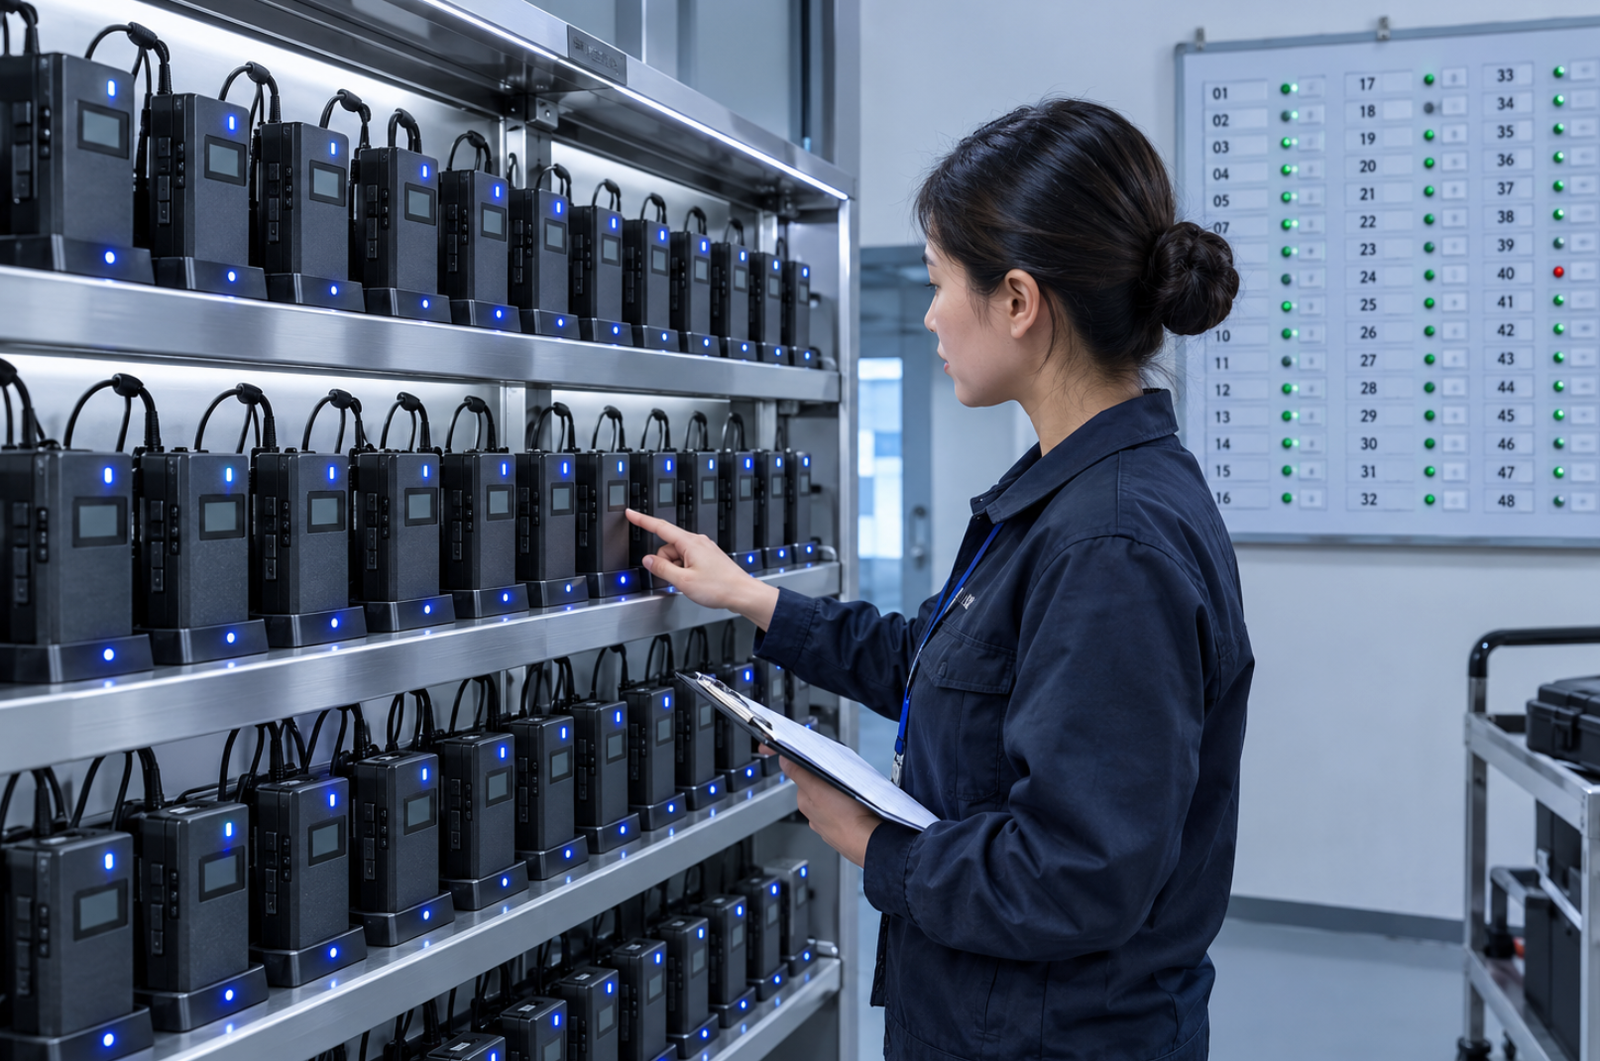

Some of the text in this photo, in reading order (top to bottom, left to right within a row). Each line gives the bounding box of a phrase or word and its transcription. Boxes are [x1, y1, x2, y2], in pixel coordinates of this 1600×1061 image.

[1497, 68, 1514, 83] 33
[1359, 76, 1376, 91] 17
[1212, 86, 1228, 100] 01
[1497, 96, 1515, 111] 34
[1360, 104, 1376, 118] 18
[1212, 113, 1229, 128] 02
[1360, 131, 1376, 146] 19
[1497, 124, 1515, 139] 35
[1212, 140, 1230, 155] 03
[1359, 159, 1377, 174] 20
[1497, 153, 1515, 167] 36
[1212, 167, 1230, 181] 04
[1359, 187, 1375, 201] 21
[1497, 181, 1515, 196] 37
[1212, 194, 1230, 208] 05
[1359, 214, 1377, 229] 22
[1497, 209, 1515, 224] 38
[1212, 221, 1230, 235] 07
[1360, 242, 1377, 257] 23
[1497, 238, 1515, 253] 39
[1360, 270, 1377, 284] 24
[1497, 266, 1515, 281] 40
[1360, 297, 1377, 312] 25
[1497, 295, 1513, 309] 41
[1215, 329, 1231, 343] 10
[1360, 325, 1377, 340] 26
[1497, 323, 1515, 337] 42
[1215, 356, 1229, 370] 11
[1360, 353, 1377, 368] 27
[1497, 351, 1515, 366] 43
[1215, 383, 1231, 397] 12
[1360, 381, 1378, 395] 28
[1497, 380, 1515, 393] 44
[1215, 410, 1231, 424] 13
[1360, 409, 1378, 423] 29
[1497, 408, 1515, 423] 45
[1216, 437, 1231, 450] 14
[1361, 436, 1378, 451] 30
[1497, 437, 1515, 451] 46
[1216, 464, 1231, 478] 15
[1361, 464, 1376, 479] 31
[1497, 465, 1515, 479] 47
[1215, 491, 1232, 505] 16
[1361, 492, 1378, 506] 32
[1497, 494, 1516, 508] 48
